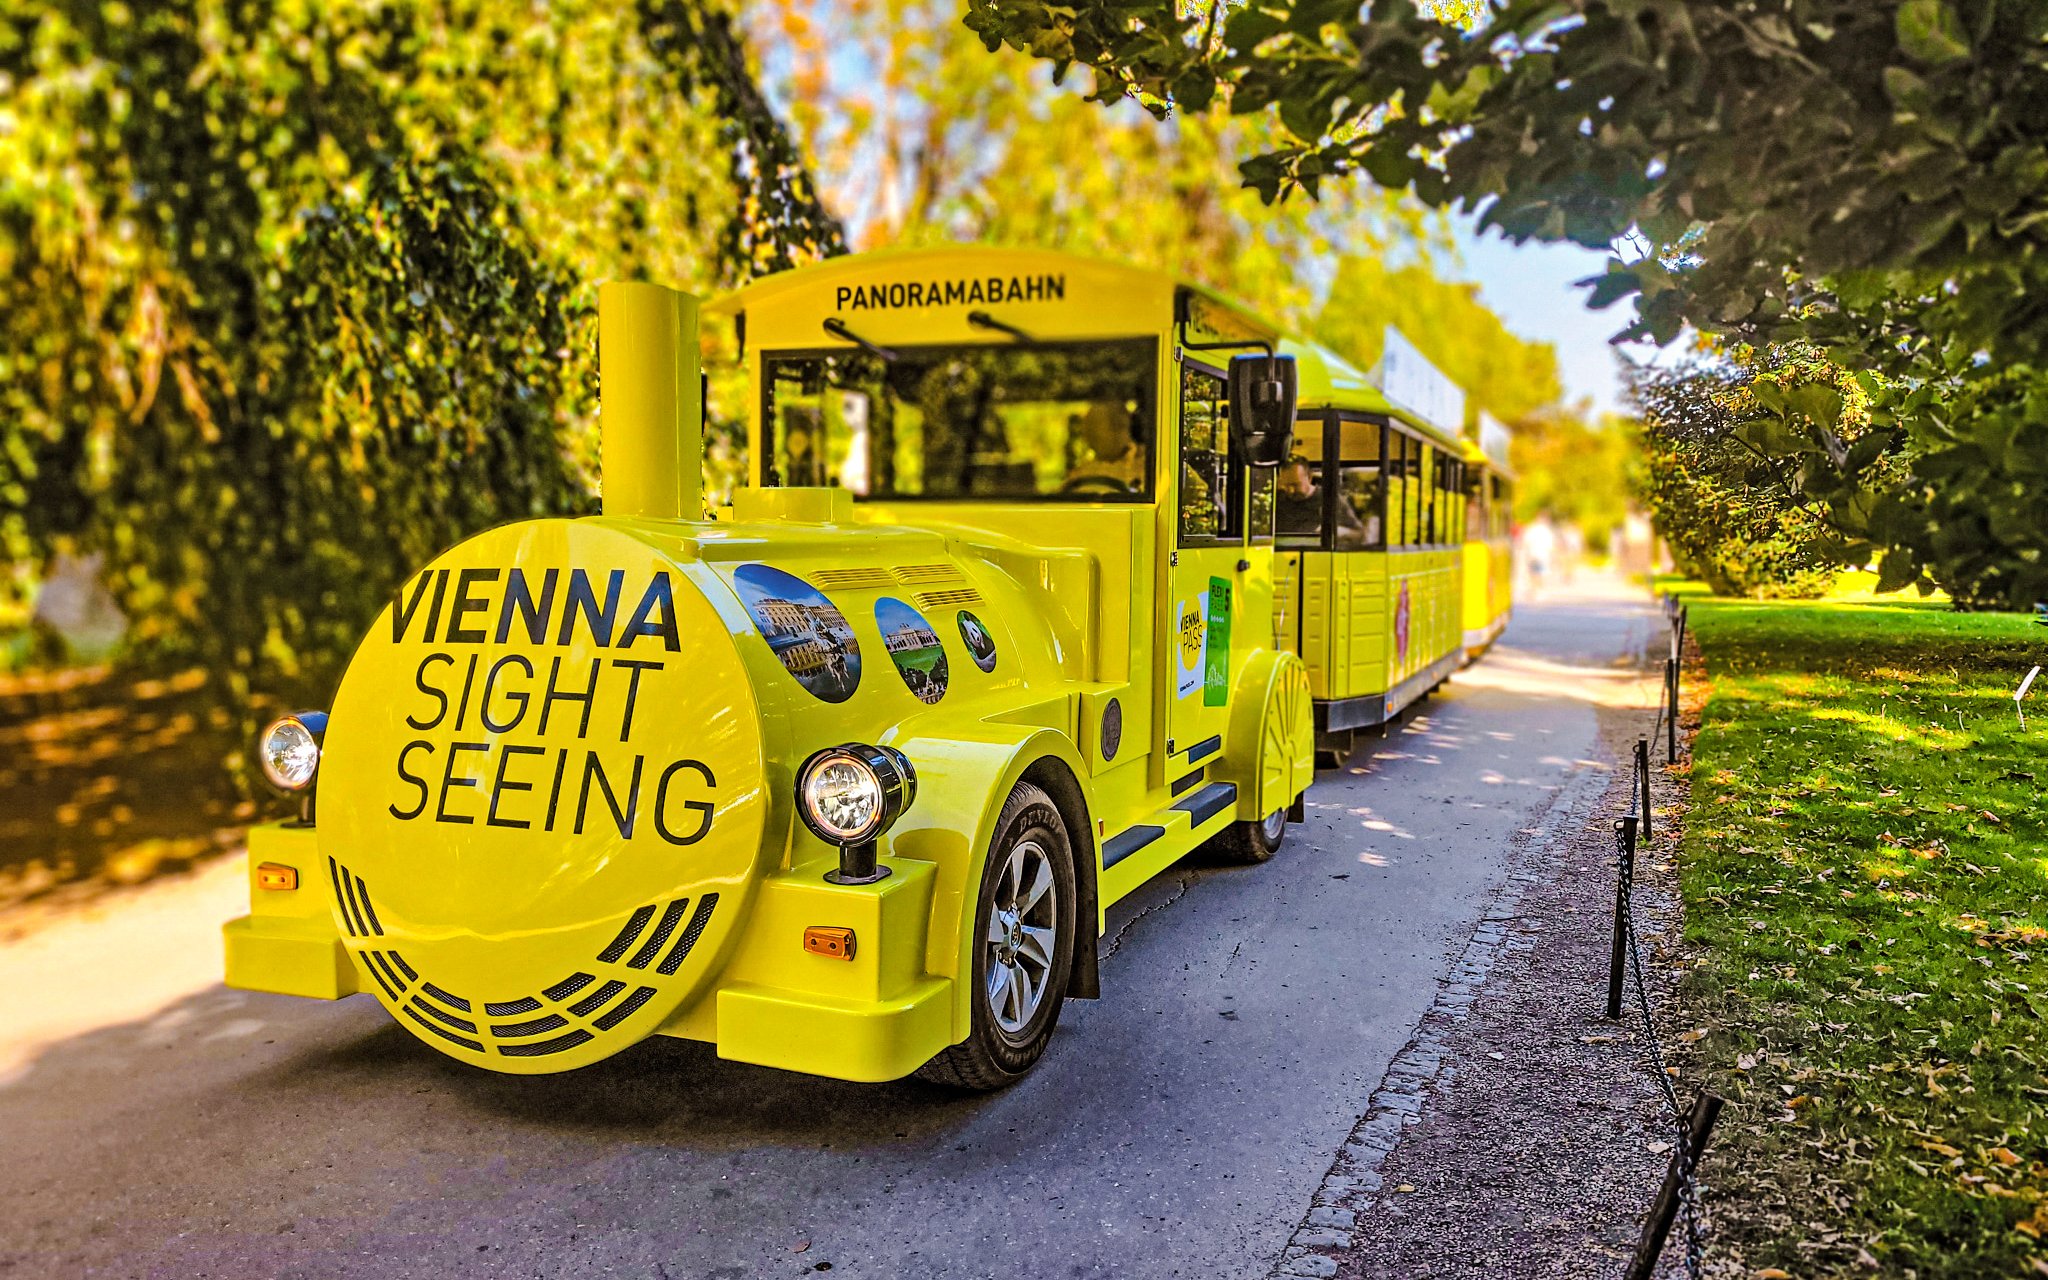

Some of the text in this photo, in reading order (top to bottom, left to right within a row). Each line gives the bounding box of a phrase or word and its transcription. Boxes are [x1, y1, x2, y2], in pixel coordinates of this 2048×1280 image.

[836, 274, 1065, 311] PANORAMABAHN
[392, 568, 681, 652] VIENNA
[1180, 610, 1200, 632] VIENNA
[1184, 624, 1203, 656] PASS
[405, 653, 664, 742] SIGHT
[388, 740, 717, 846] SEEING
[1019, 809, 1060, 834] DUNLO
